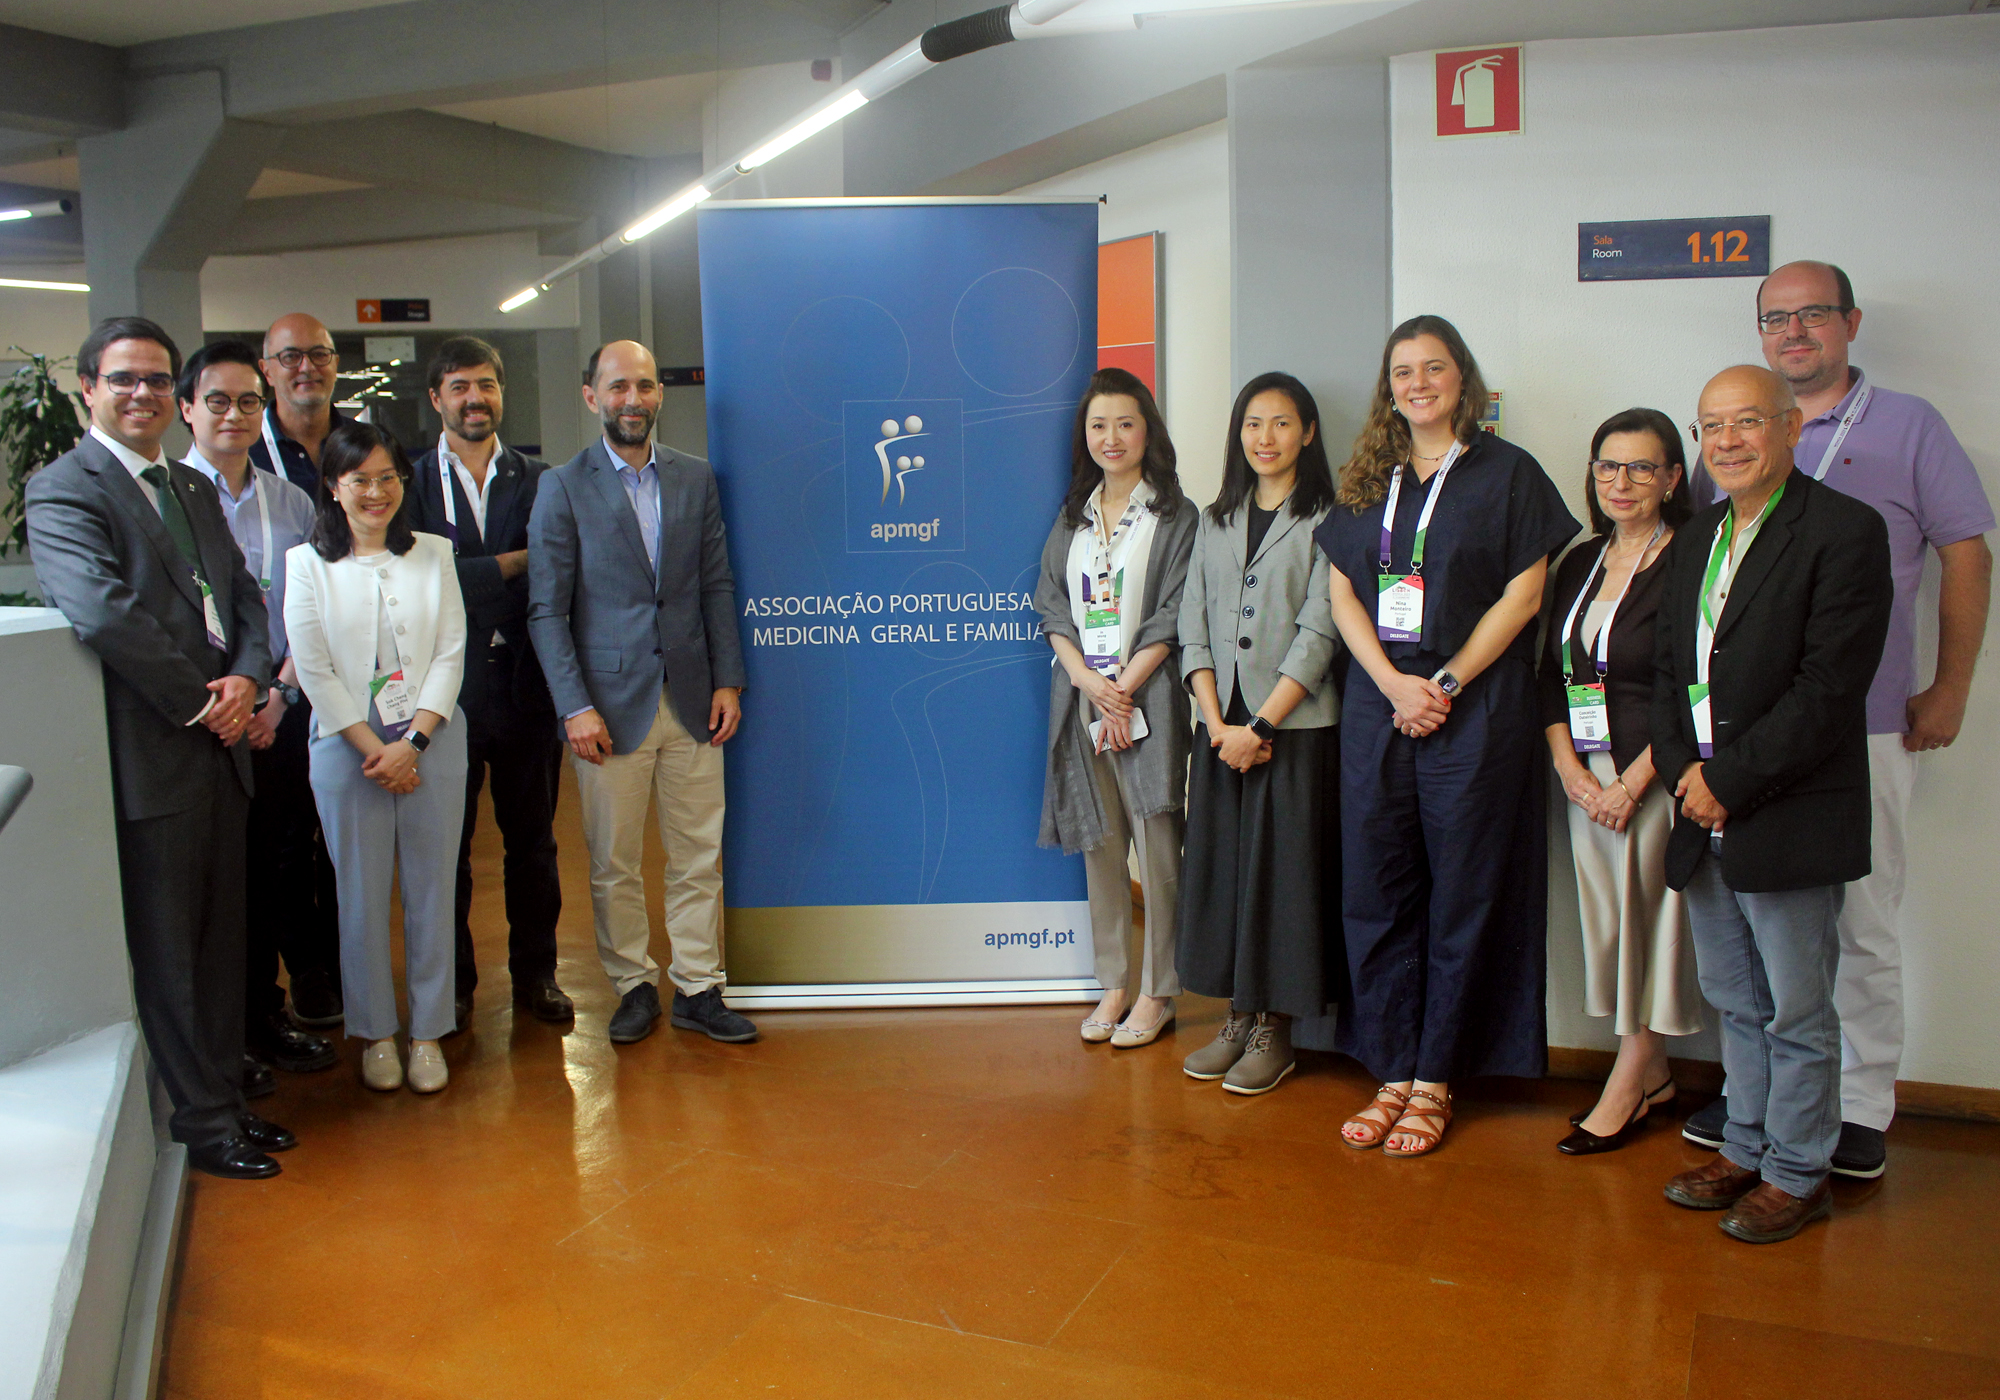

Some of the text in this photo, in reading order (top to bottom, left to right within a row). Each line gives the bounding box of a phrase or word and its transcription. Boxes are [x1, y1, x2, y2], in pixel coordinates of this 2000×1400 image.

[1593, 235, 1613, 245] Sala
[1687, 230, 1749, 263] 1.12
[1592, 249, 1623, 259] Room
[870, 518, 940, 543] apmgf
[744, 592, 1034, 619] ASSOCIAÇÃO PORTUGUESA
[753, 625, 861, 647] MEDICINA
[870, 624, 941, 644] GERAL
[946, 623, 958, 642] E
[984, 928, 1075, 950] apmgf.pt
